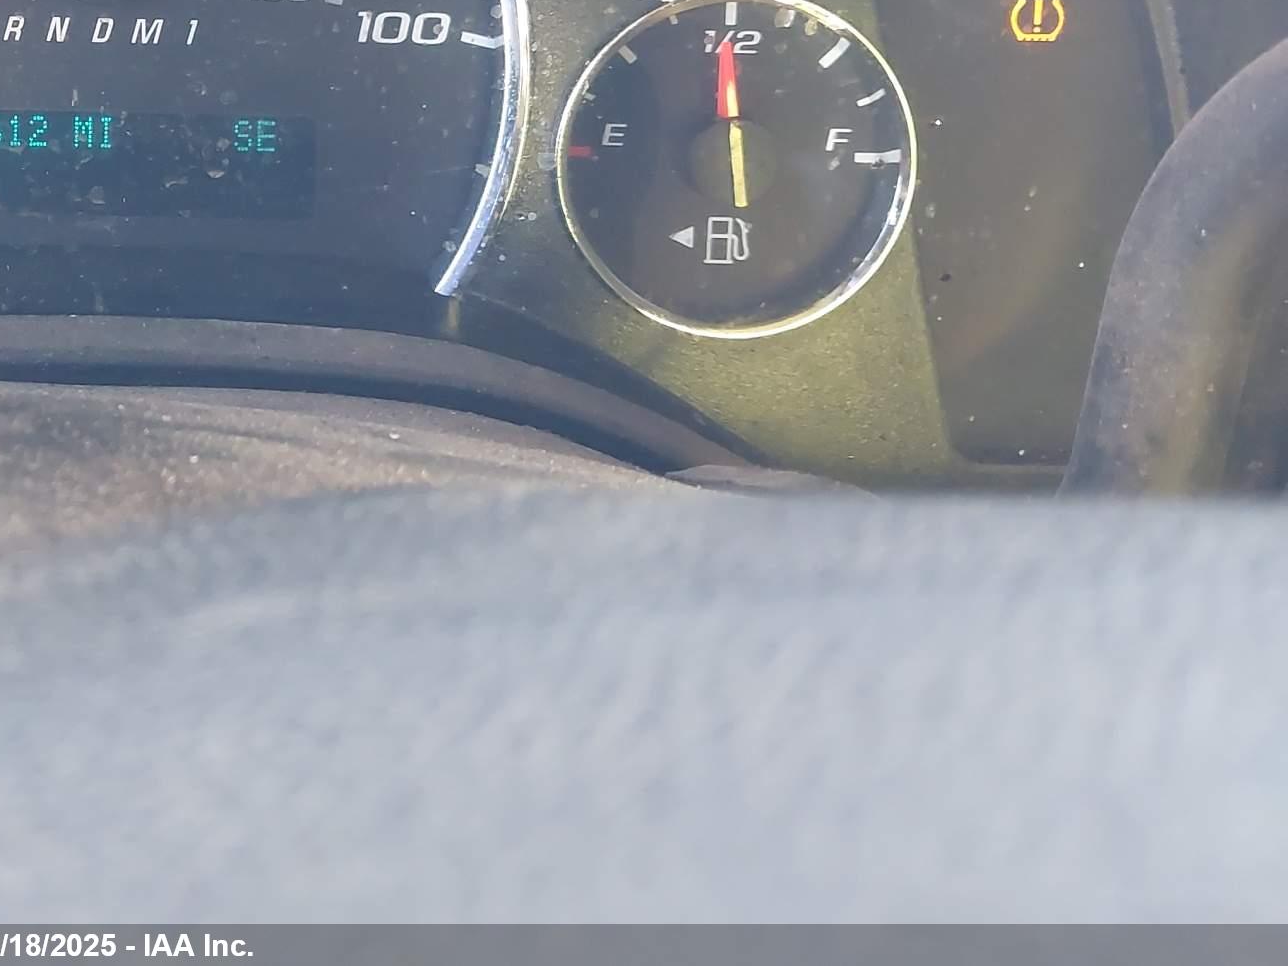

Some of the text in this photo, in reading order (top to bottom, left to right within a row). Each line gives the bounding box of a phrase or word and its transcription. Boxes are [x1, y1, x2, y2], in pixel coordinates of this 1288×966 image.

[356, 11, 451, 46] 100
[73, 115, 112, 149] MI
[232, 119, 277, 153] SE
[601, 123, 628, 147] E
[824, 128, 853, 152] F
